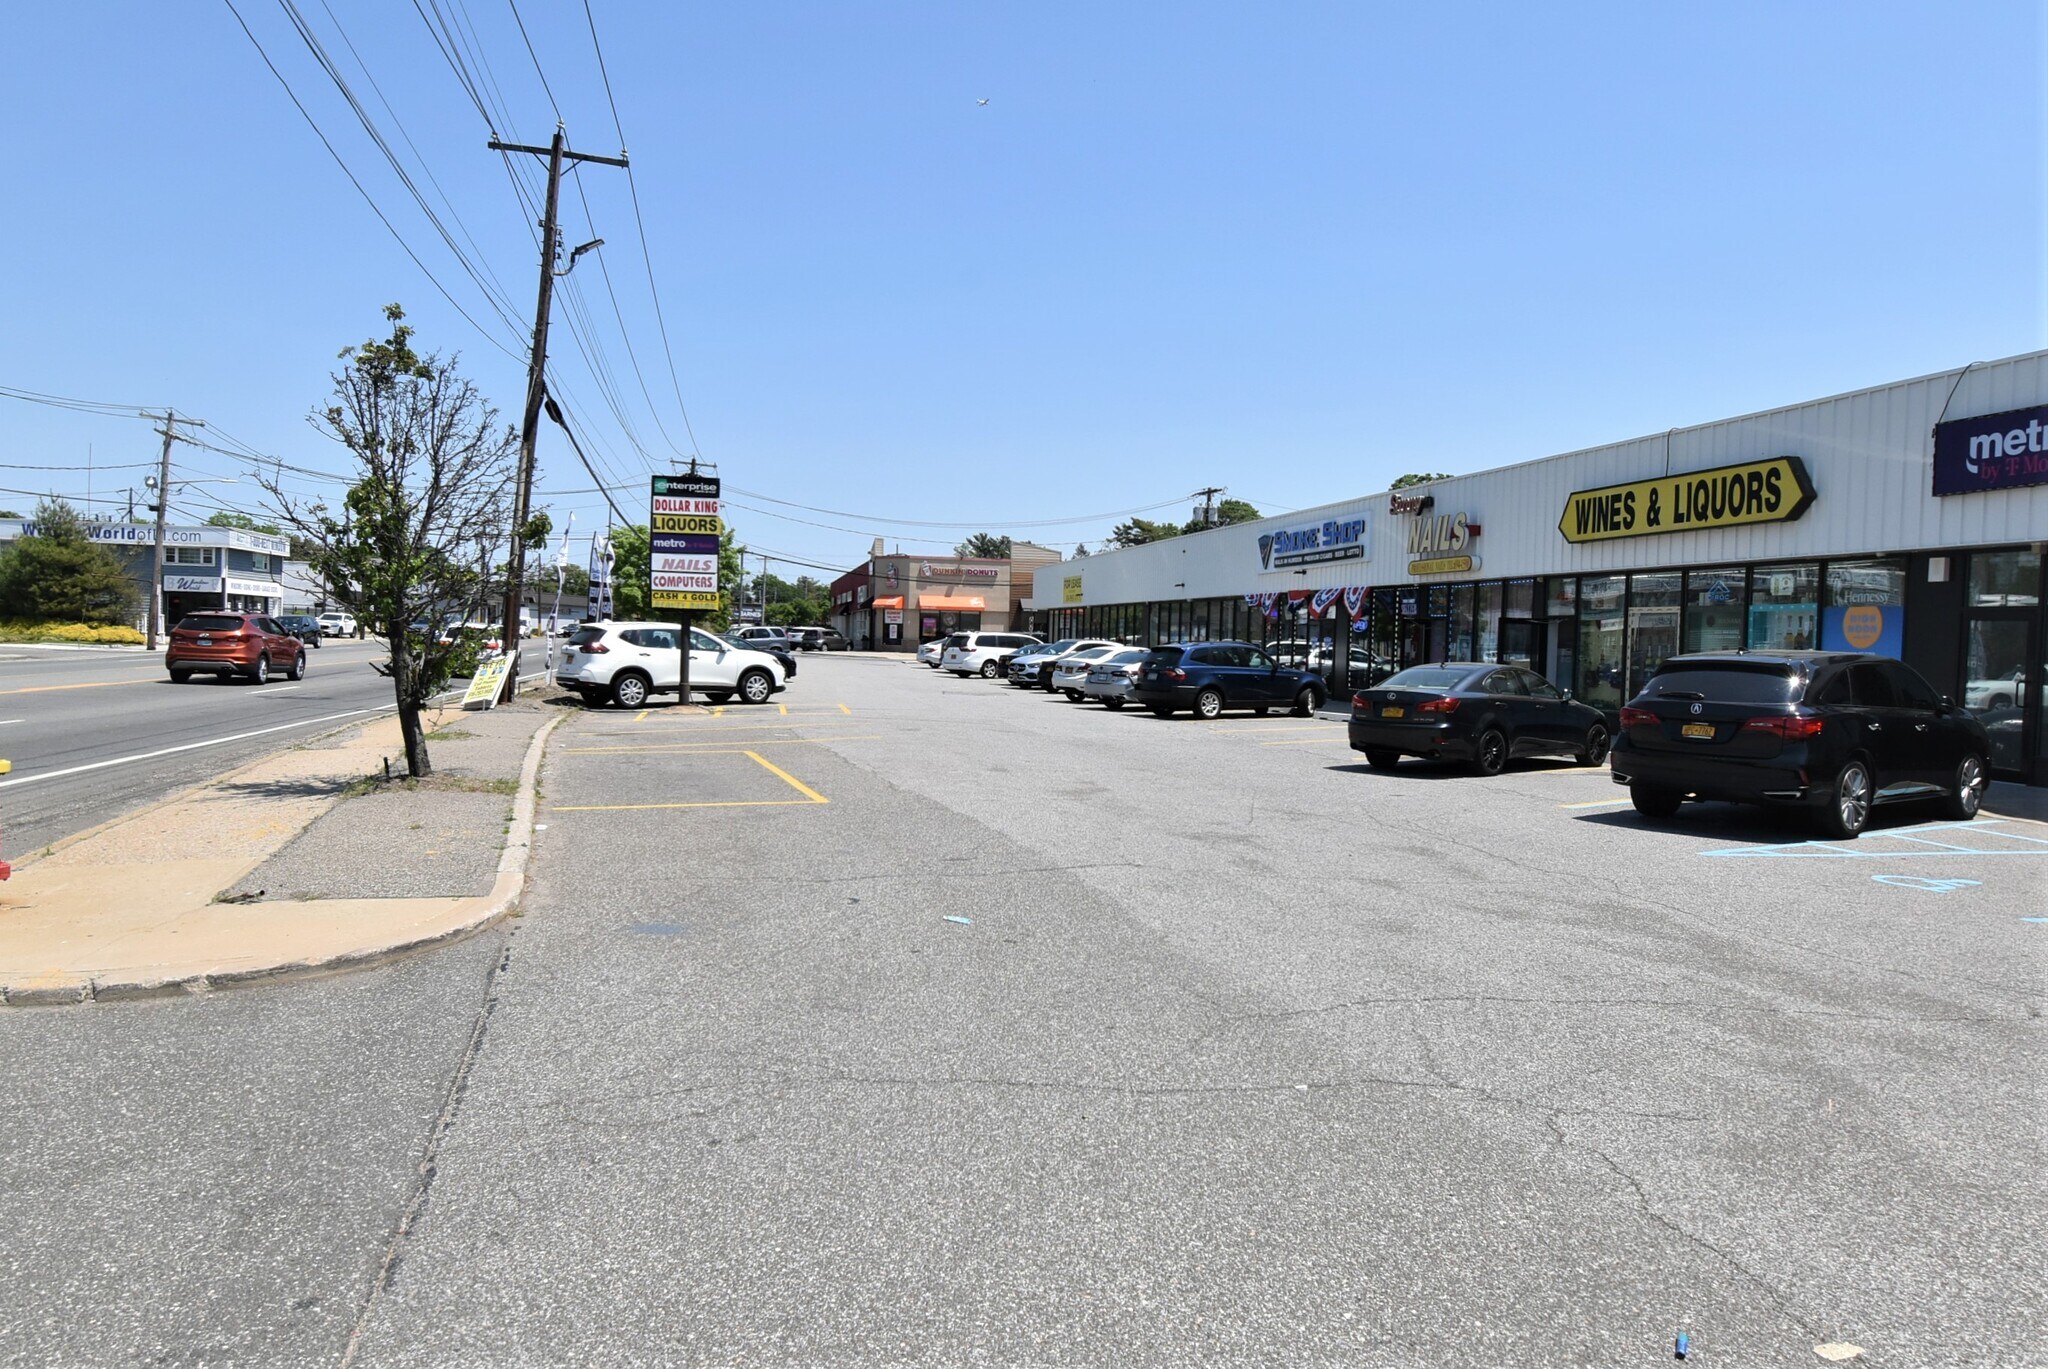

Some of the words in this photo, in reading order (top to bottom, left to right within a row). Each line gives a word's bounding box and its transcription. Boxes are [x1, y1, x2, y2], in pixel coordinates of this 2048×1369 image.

[655, 482, 717, 491] enterprise
[655, 499, 691, 512] DOLLAR
[694, 500, 718, 513] KING
[1575, 491, 1636, 535] WINES
[1646, 487, 1661, 528] &
[1673, 466, 1782, 523] LIQUORS
[653, 517, 717, 532] LIQUORS
[1274, 528, 1320, 554] SMOKE
[1322, 520, 1365, 546] SHOP
[1407, 511, 1469, 554] NAILS
[653, 538, 686, 548] metro
[661, 558, 713, 571] NAILS
[966, 568, 999, 576] DONUTS
[653, 575, 713, 588] COMPUTERS
[653, 592, 678, 600] CASH
[691, 594, 717, 602] GOLD
[1844, 590, 1890, 605] Hennessy
